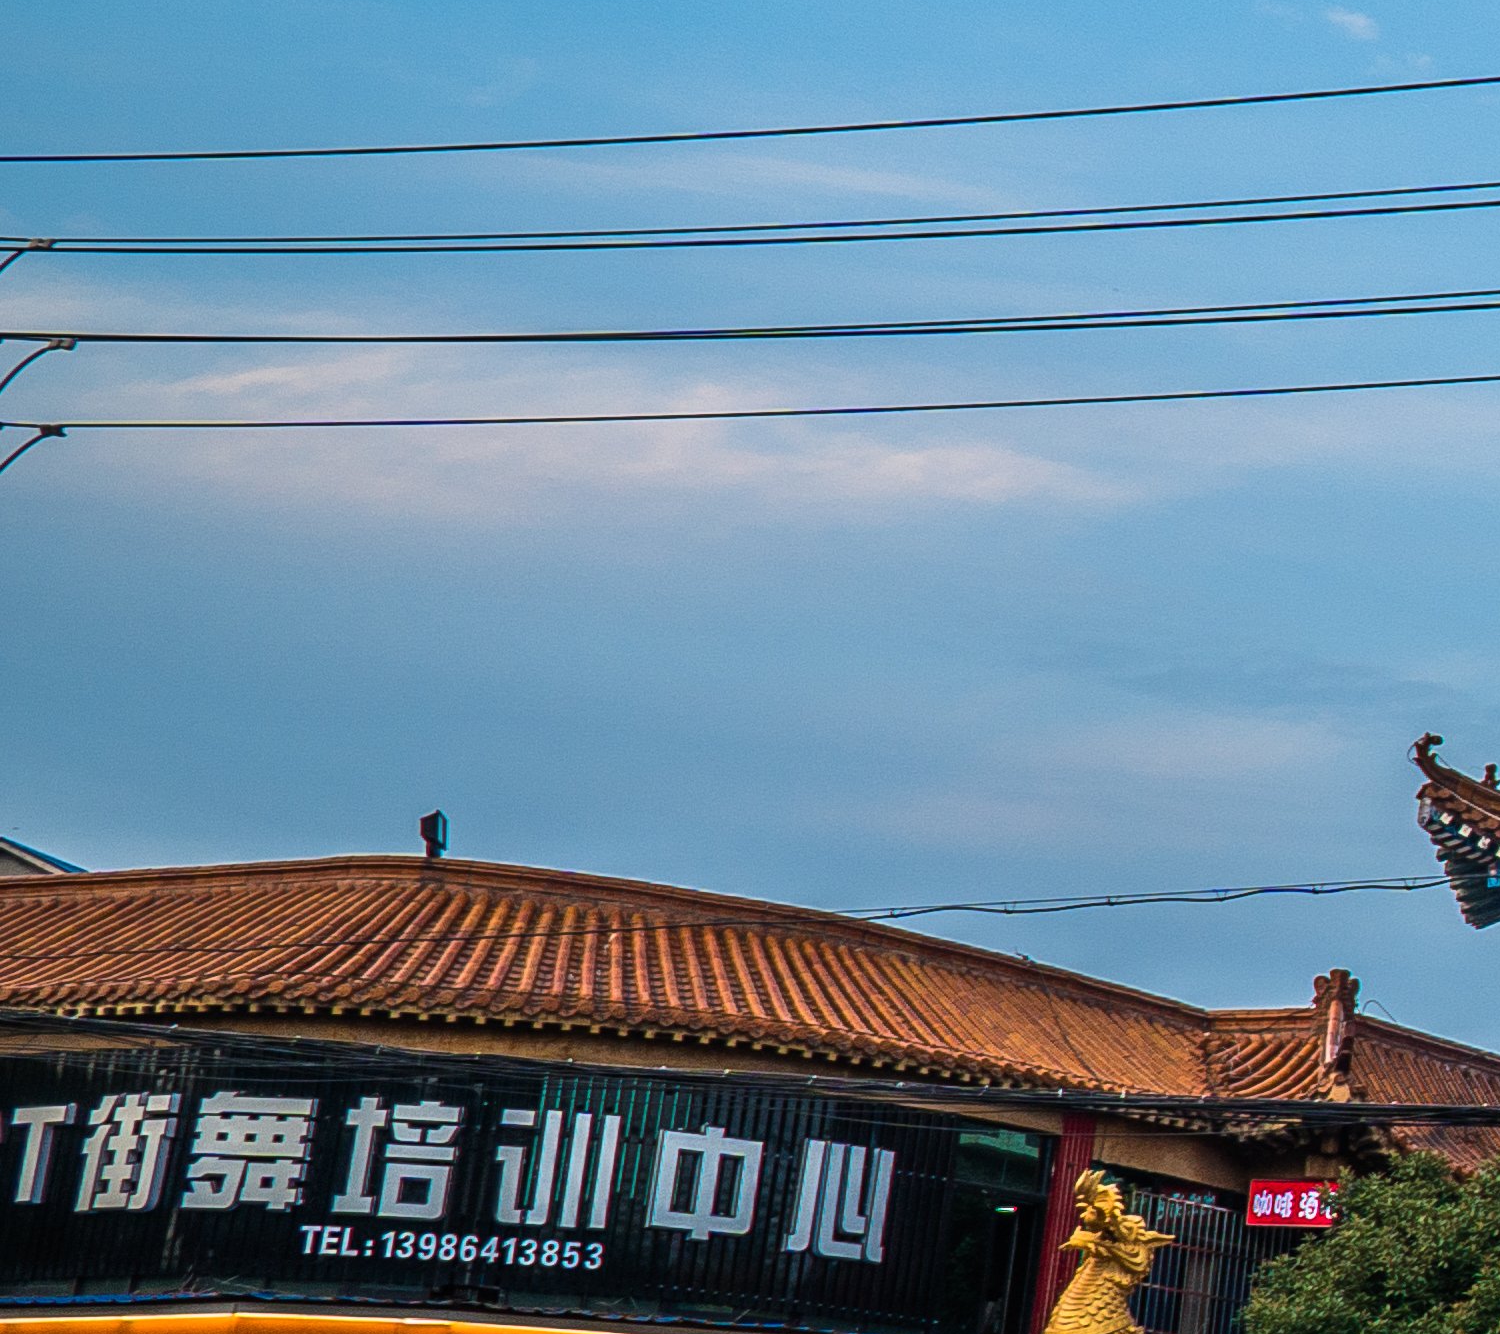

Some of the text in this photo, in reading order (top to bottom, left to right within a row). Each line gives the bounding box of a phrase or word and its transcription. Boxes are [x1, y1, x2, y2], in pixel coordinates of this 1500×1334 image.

[11, 1091, 896, 1264] T街舞培训中心
[300, 1225, 604, 1270] TEL:13986413853
